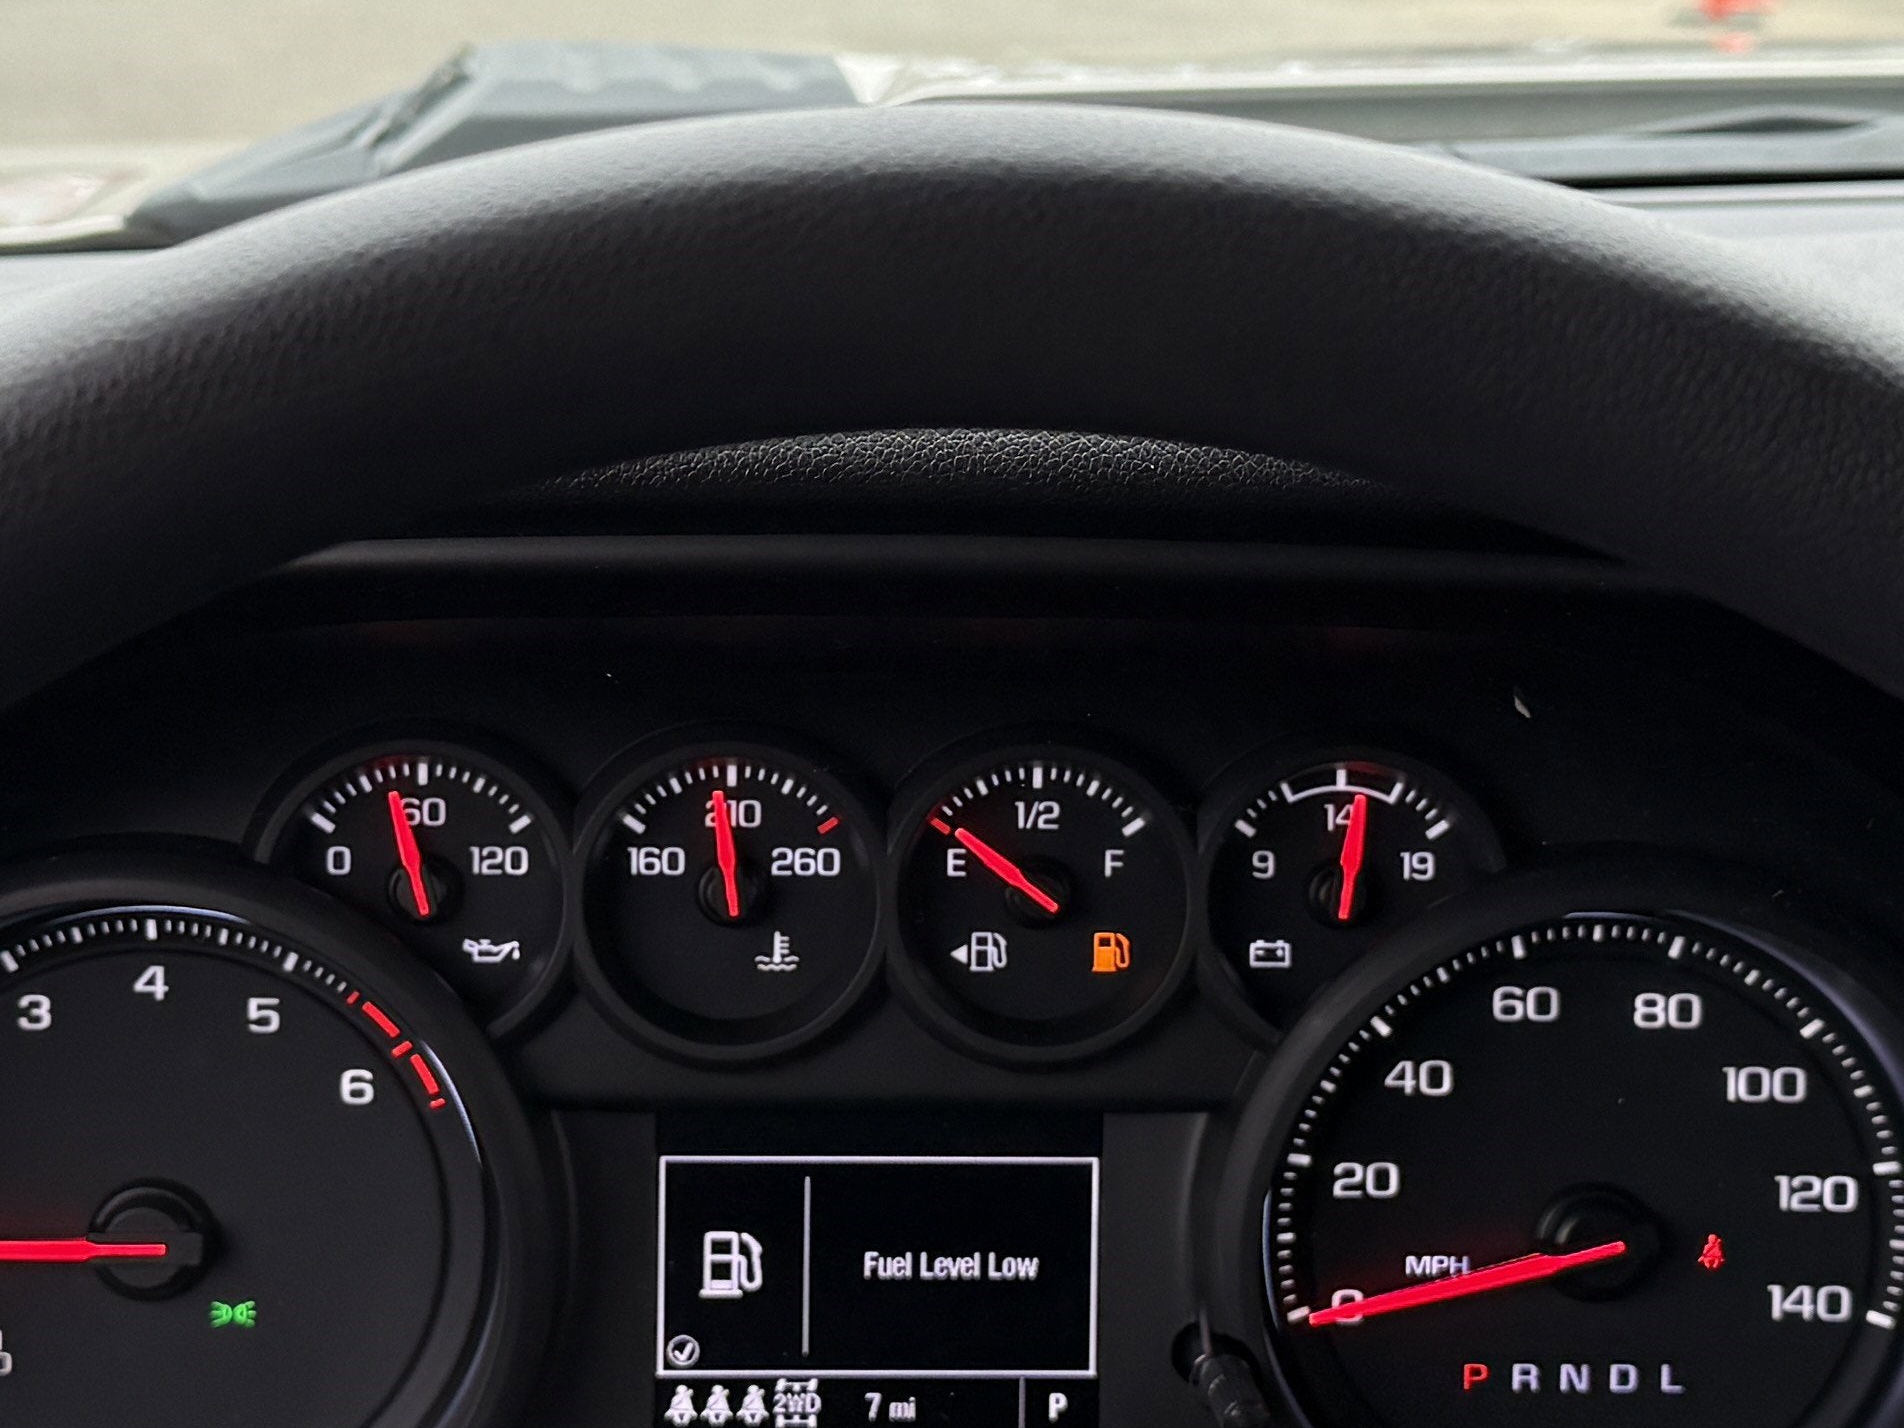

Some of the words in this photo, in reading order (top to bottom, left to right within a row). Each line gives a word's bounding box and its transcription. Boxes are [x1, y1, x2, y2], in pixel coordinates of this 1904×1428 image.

[404, 797, 446, 828] 60
[1015, 802, 1059, 831] 1/2
[327, 847, 351, 876] 0
[471, 847, 528, 876] 120
[629, 848, 685, 876] 160
[771, 848, 840, 877] 260
[948, 850, 966, 877] E
[1105, 850, 1124, 877] F
[1252, 851, 1275, 878] 9
[1400, 852, 1434, 879] 19
[133, 966, 169, 1000] 4
[18, 995, 51, 1029] 3
[247, 998, 280, 1034] 5
[1493, 987, 1559, 1021] 60
[1633, 994, 1700, 1028] 80
[340, 1069, 374, 1103] 6
[1385, 1061, 1452, 1095] 40
[1723, 1066, 1806, 1103] 100
[1332, 1162, 1399, 1198] 20
[1775, 1176, 1857, 1211] 120
[864, 1252, 912, 1280] Fuel
[920, 1252, 980, 1280] Level
[988, 1252, 1039, 1280] Low
[1405, 1255, 1469, 1277] MPH
[1767, 1284, 1851, 1321] 140
[1463, 1364, 1488, 1389] P
[1512, 1364, 1539, 1391] R
[1560, 1364, 1589, 1391] N
[1610, 1364, 1637, 1392] D
[1660, 1364, 1683, 1392] L
[864, 1393, 881, 1422] 7
[889, 1397, 917, 1422] mi
[1049, 1394, 1067, 1422] P
